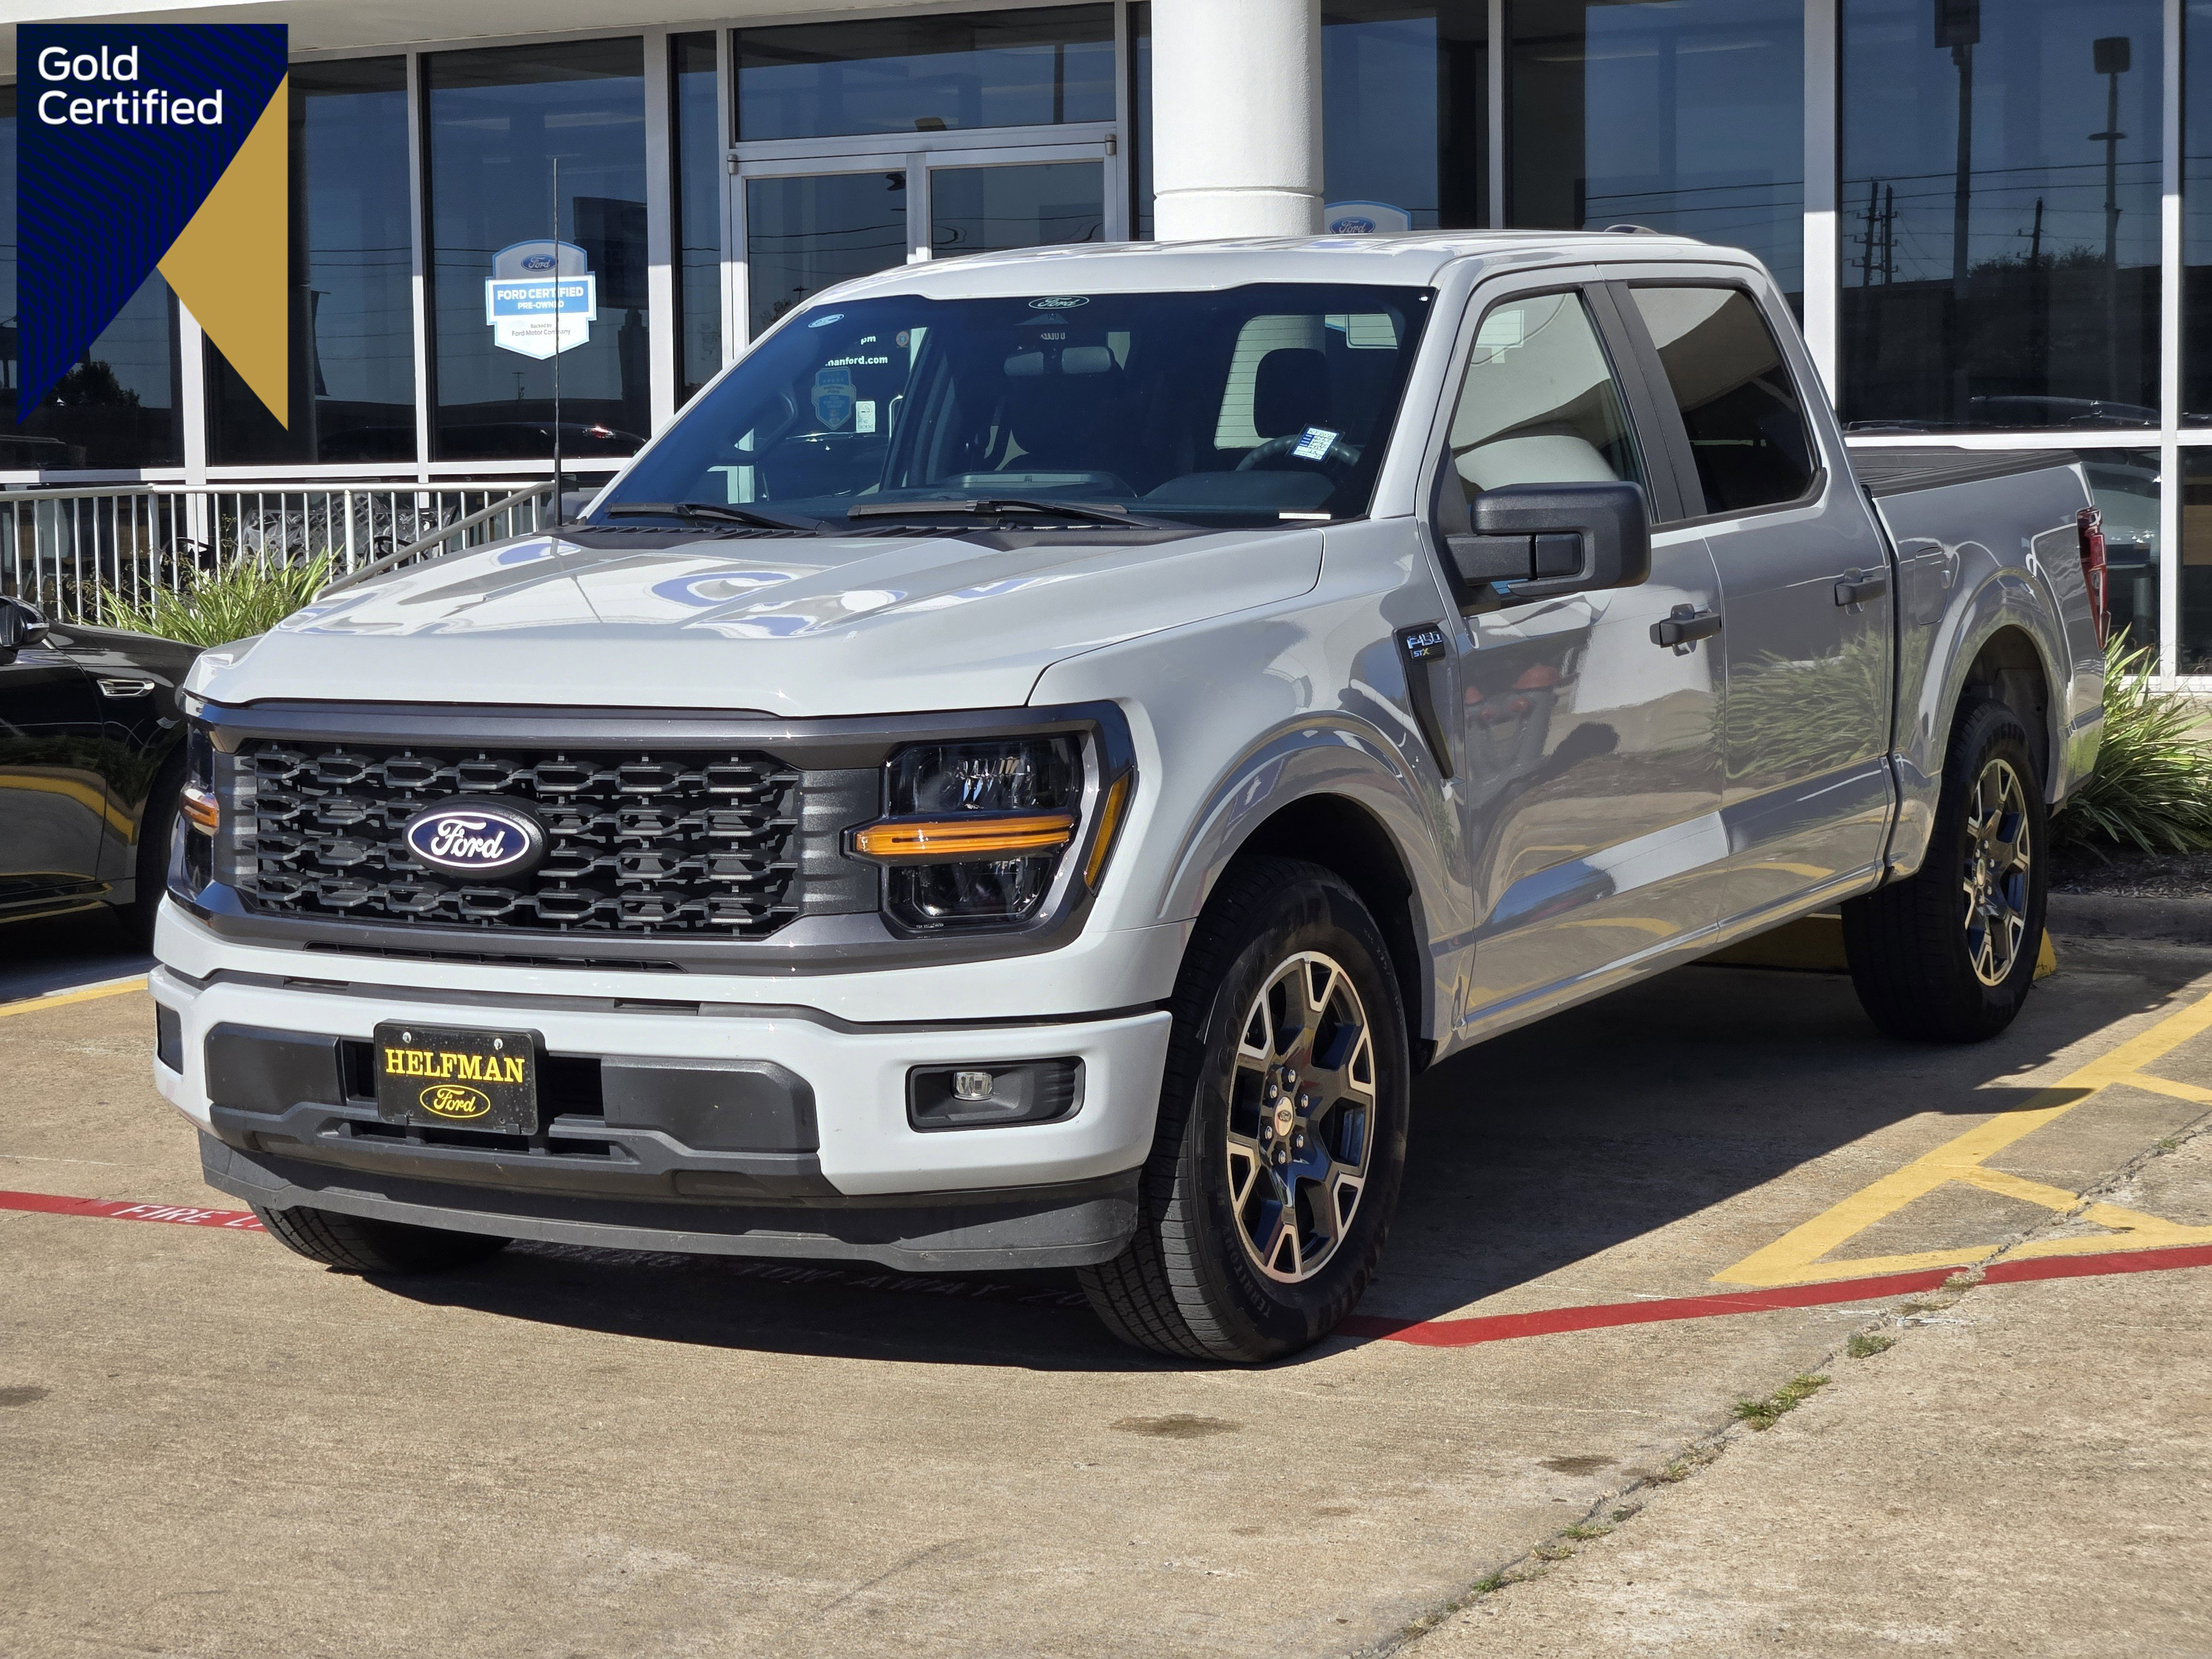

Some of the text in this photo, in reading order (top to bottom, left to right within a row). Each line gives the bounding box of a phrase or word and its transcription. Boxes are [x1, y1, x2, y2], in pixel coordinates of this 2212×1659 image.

[1339, 221, 1366, 233] Ford
[528, 257, 550, 268] Ford
[497, 286, 584, 300] FORD CERTFIED
[1037, 298, 1080, 307] Ford
[1413, 648, 1430, 658] STX
[431, 819, 505, 859] Ford
[385, 1049, 525, 1083] HELFMAN
[434, 1088, 476, 1112] Ford
[110, 1204, 231, 1223] FIRE
